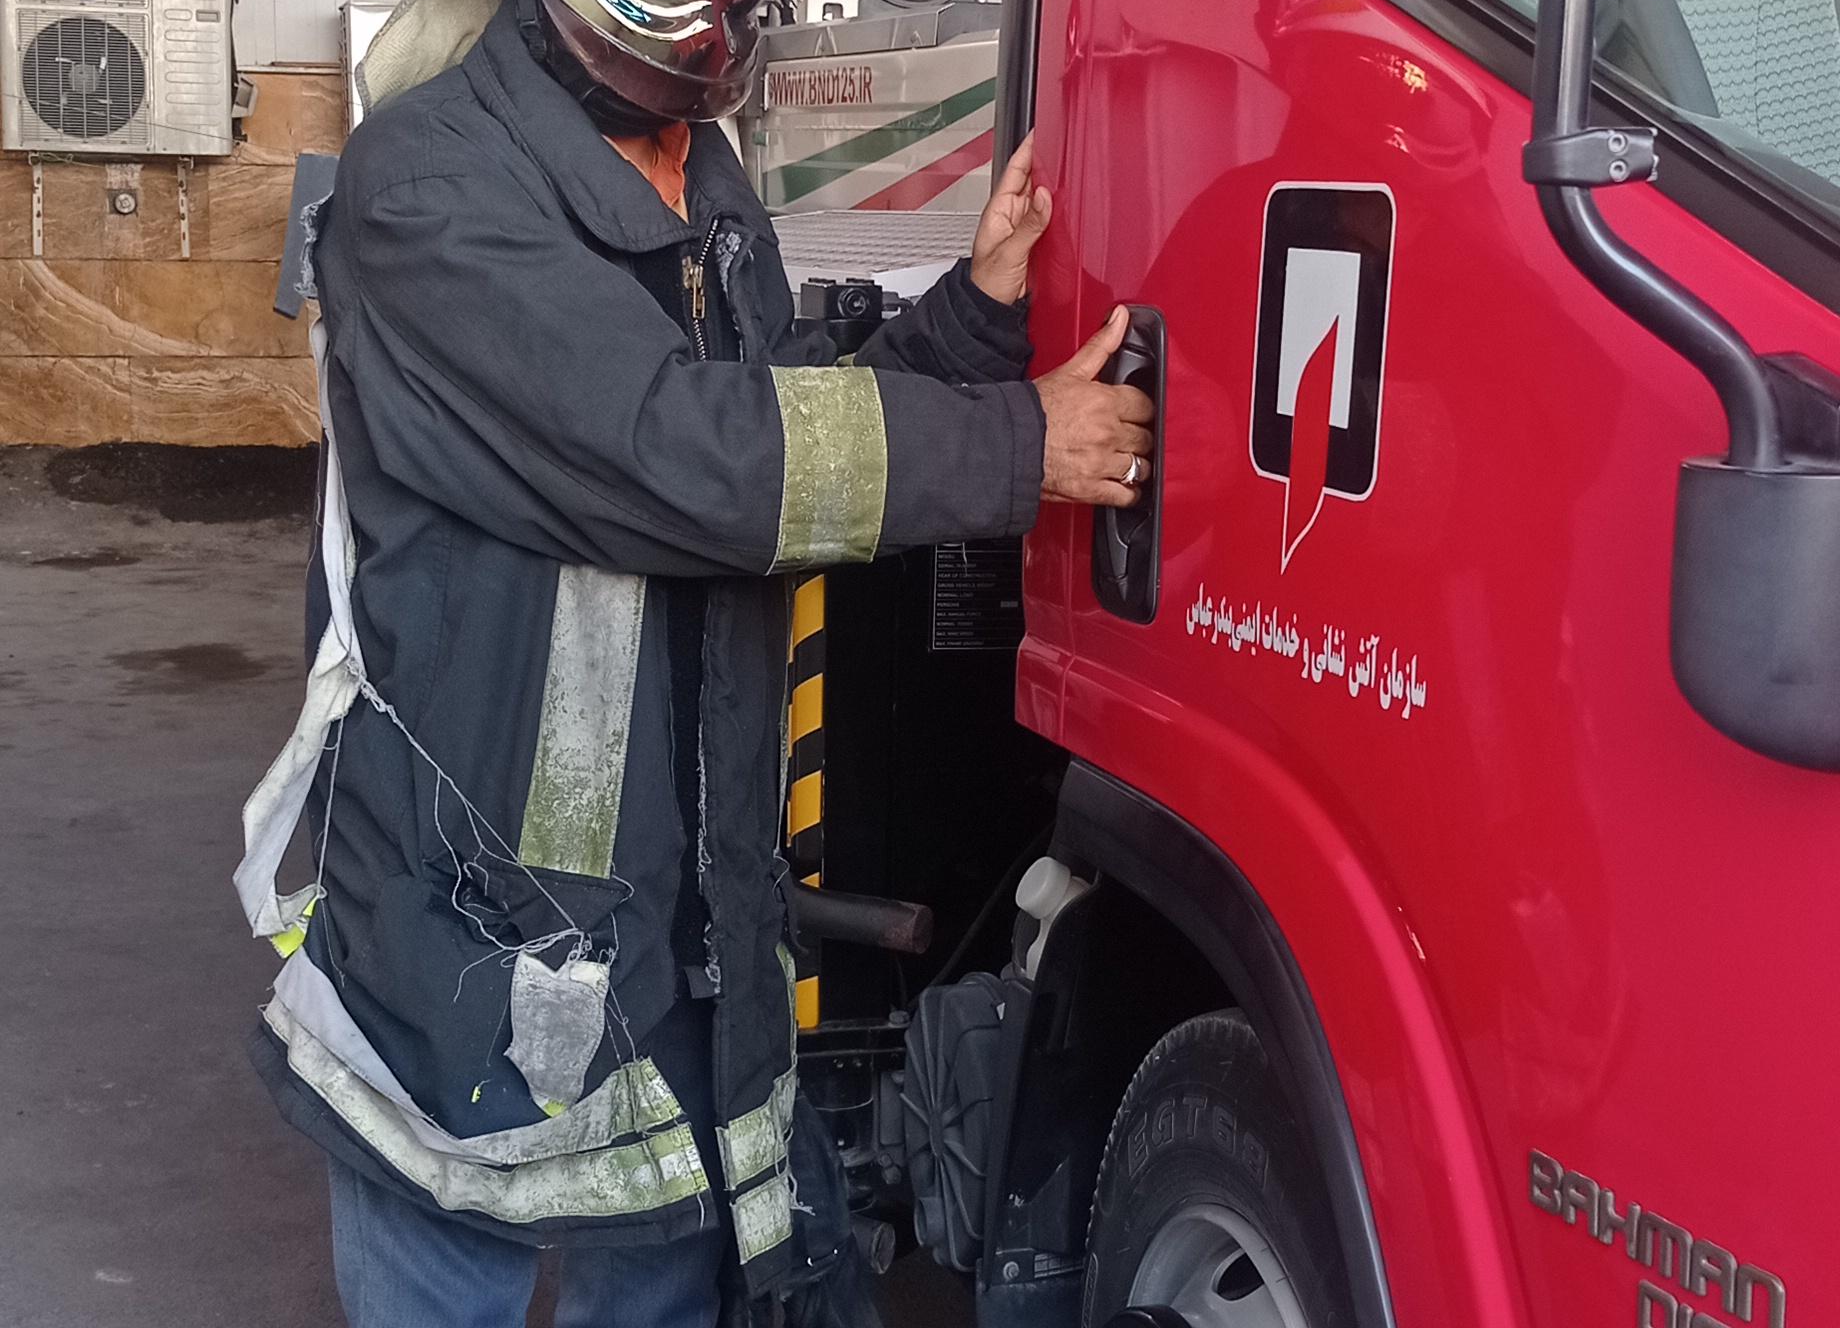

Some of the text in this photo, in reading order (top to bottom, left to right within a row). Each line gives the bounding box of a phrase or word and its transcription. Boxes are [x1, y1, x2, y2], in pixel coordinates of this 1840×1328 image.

[1231, 600, 1261, 656] ایمنی
[1262, 606, 1300, 658] خدمات
[1311, 623, 1346, 684] نشانی
[1301, 637, 1310, 679] و
[1348, 634, 1380, 698] آتش
[1378, 646, 1427, 720] سازمان
